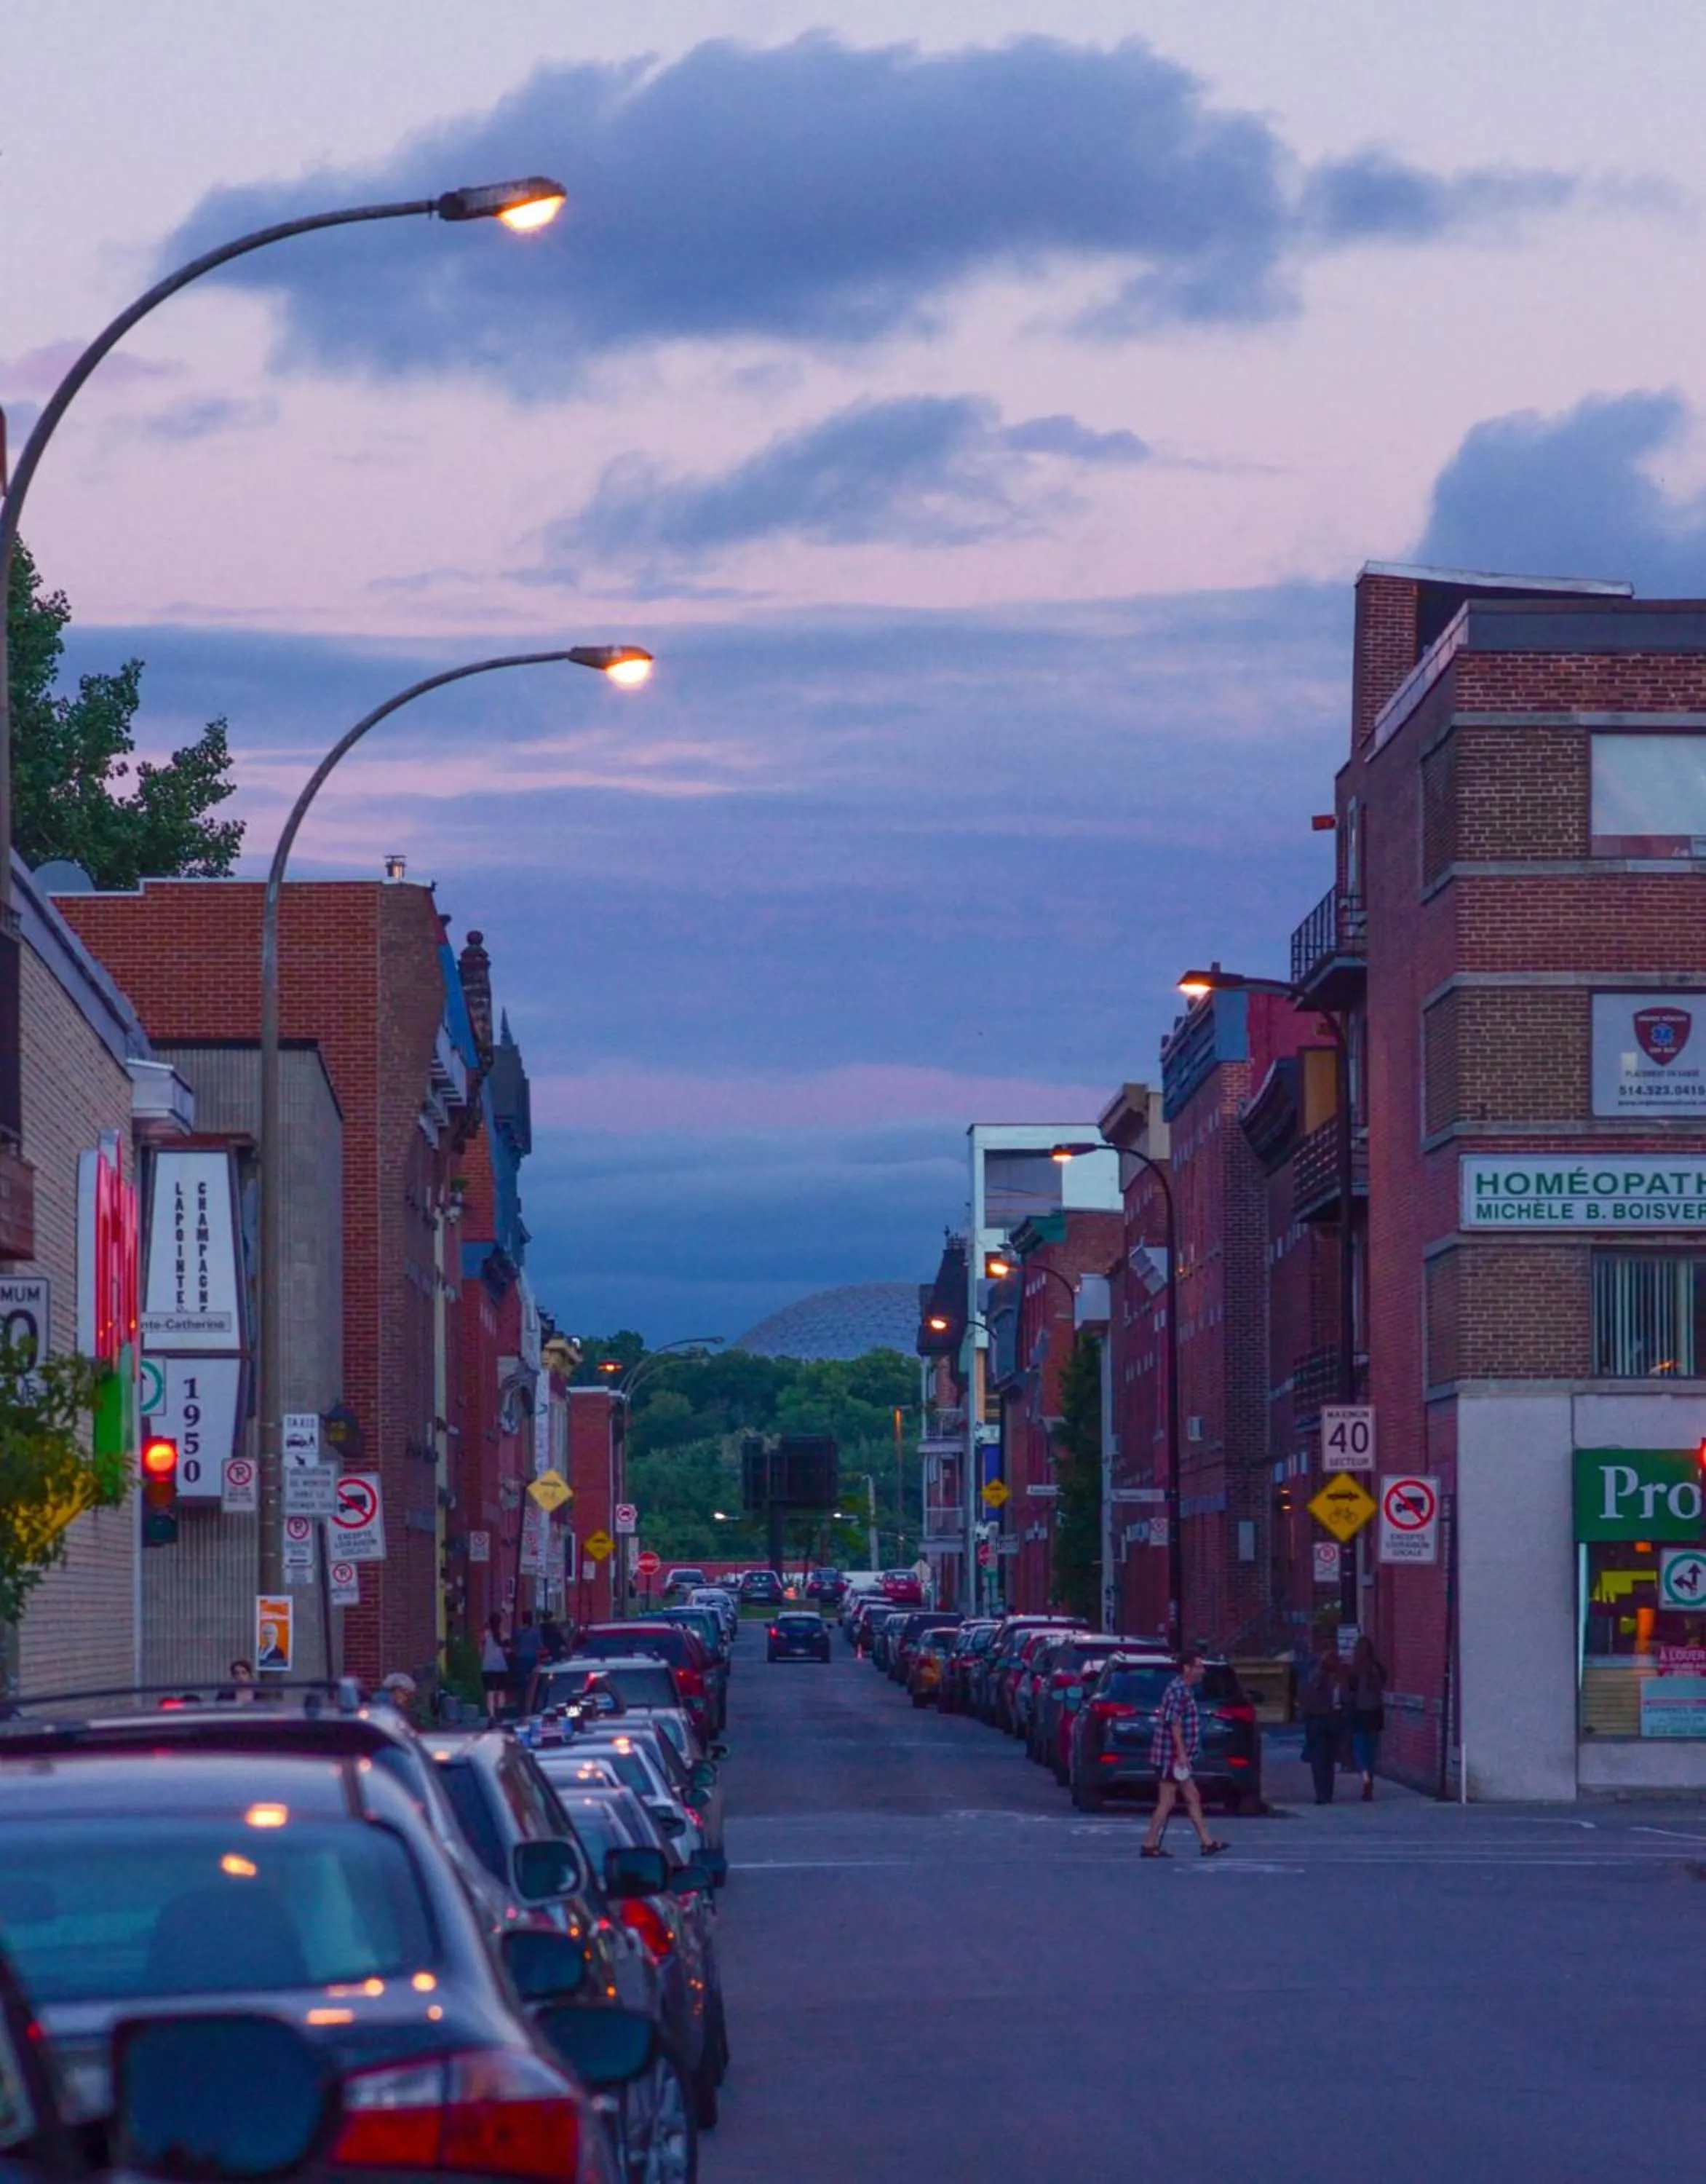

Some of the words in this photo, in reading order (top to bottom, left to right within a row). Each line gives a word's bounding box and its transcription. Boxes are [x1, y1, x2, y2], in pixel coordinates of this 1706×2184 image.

[1476, 1200, 1574, 1219] MICHÈLE
[1587, 1203, 1606, 1219] B.
[175, 1182, 185, 1303] LAPOINTE
[183, 1377, 201, 1484] 1950
[1328, 1421, 1369, 1454] 40
[1598, 1465, 1702, 1519] Pro
